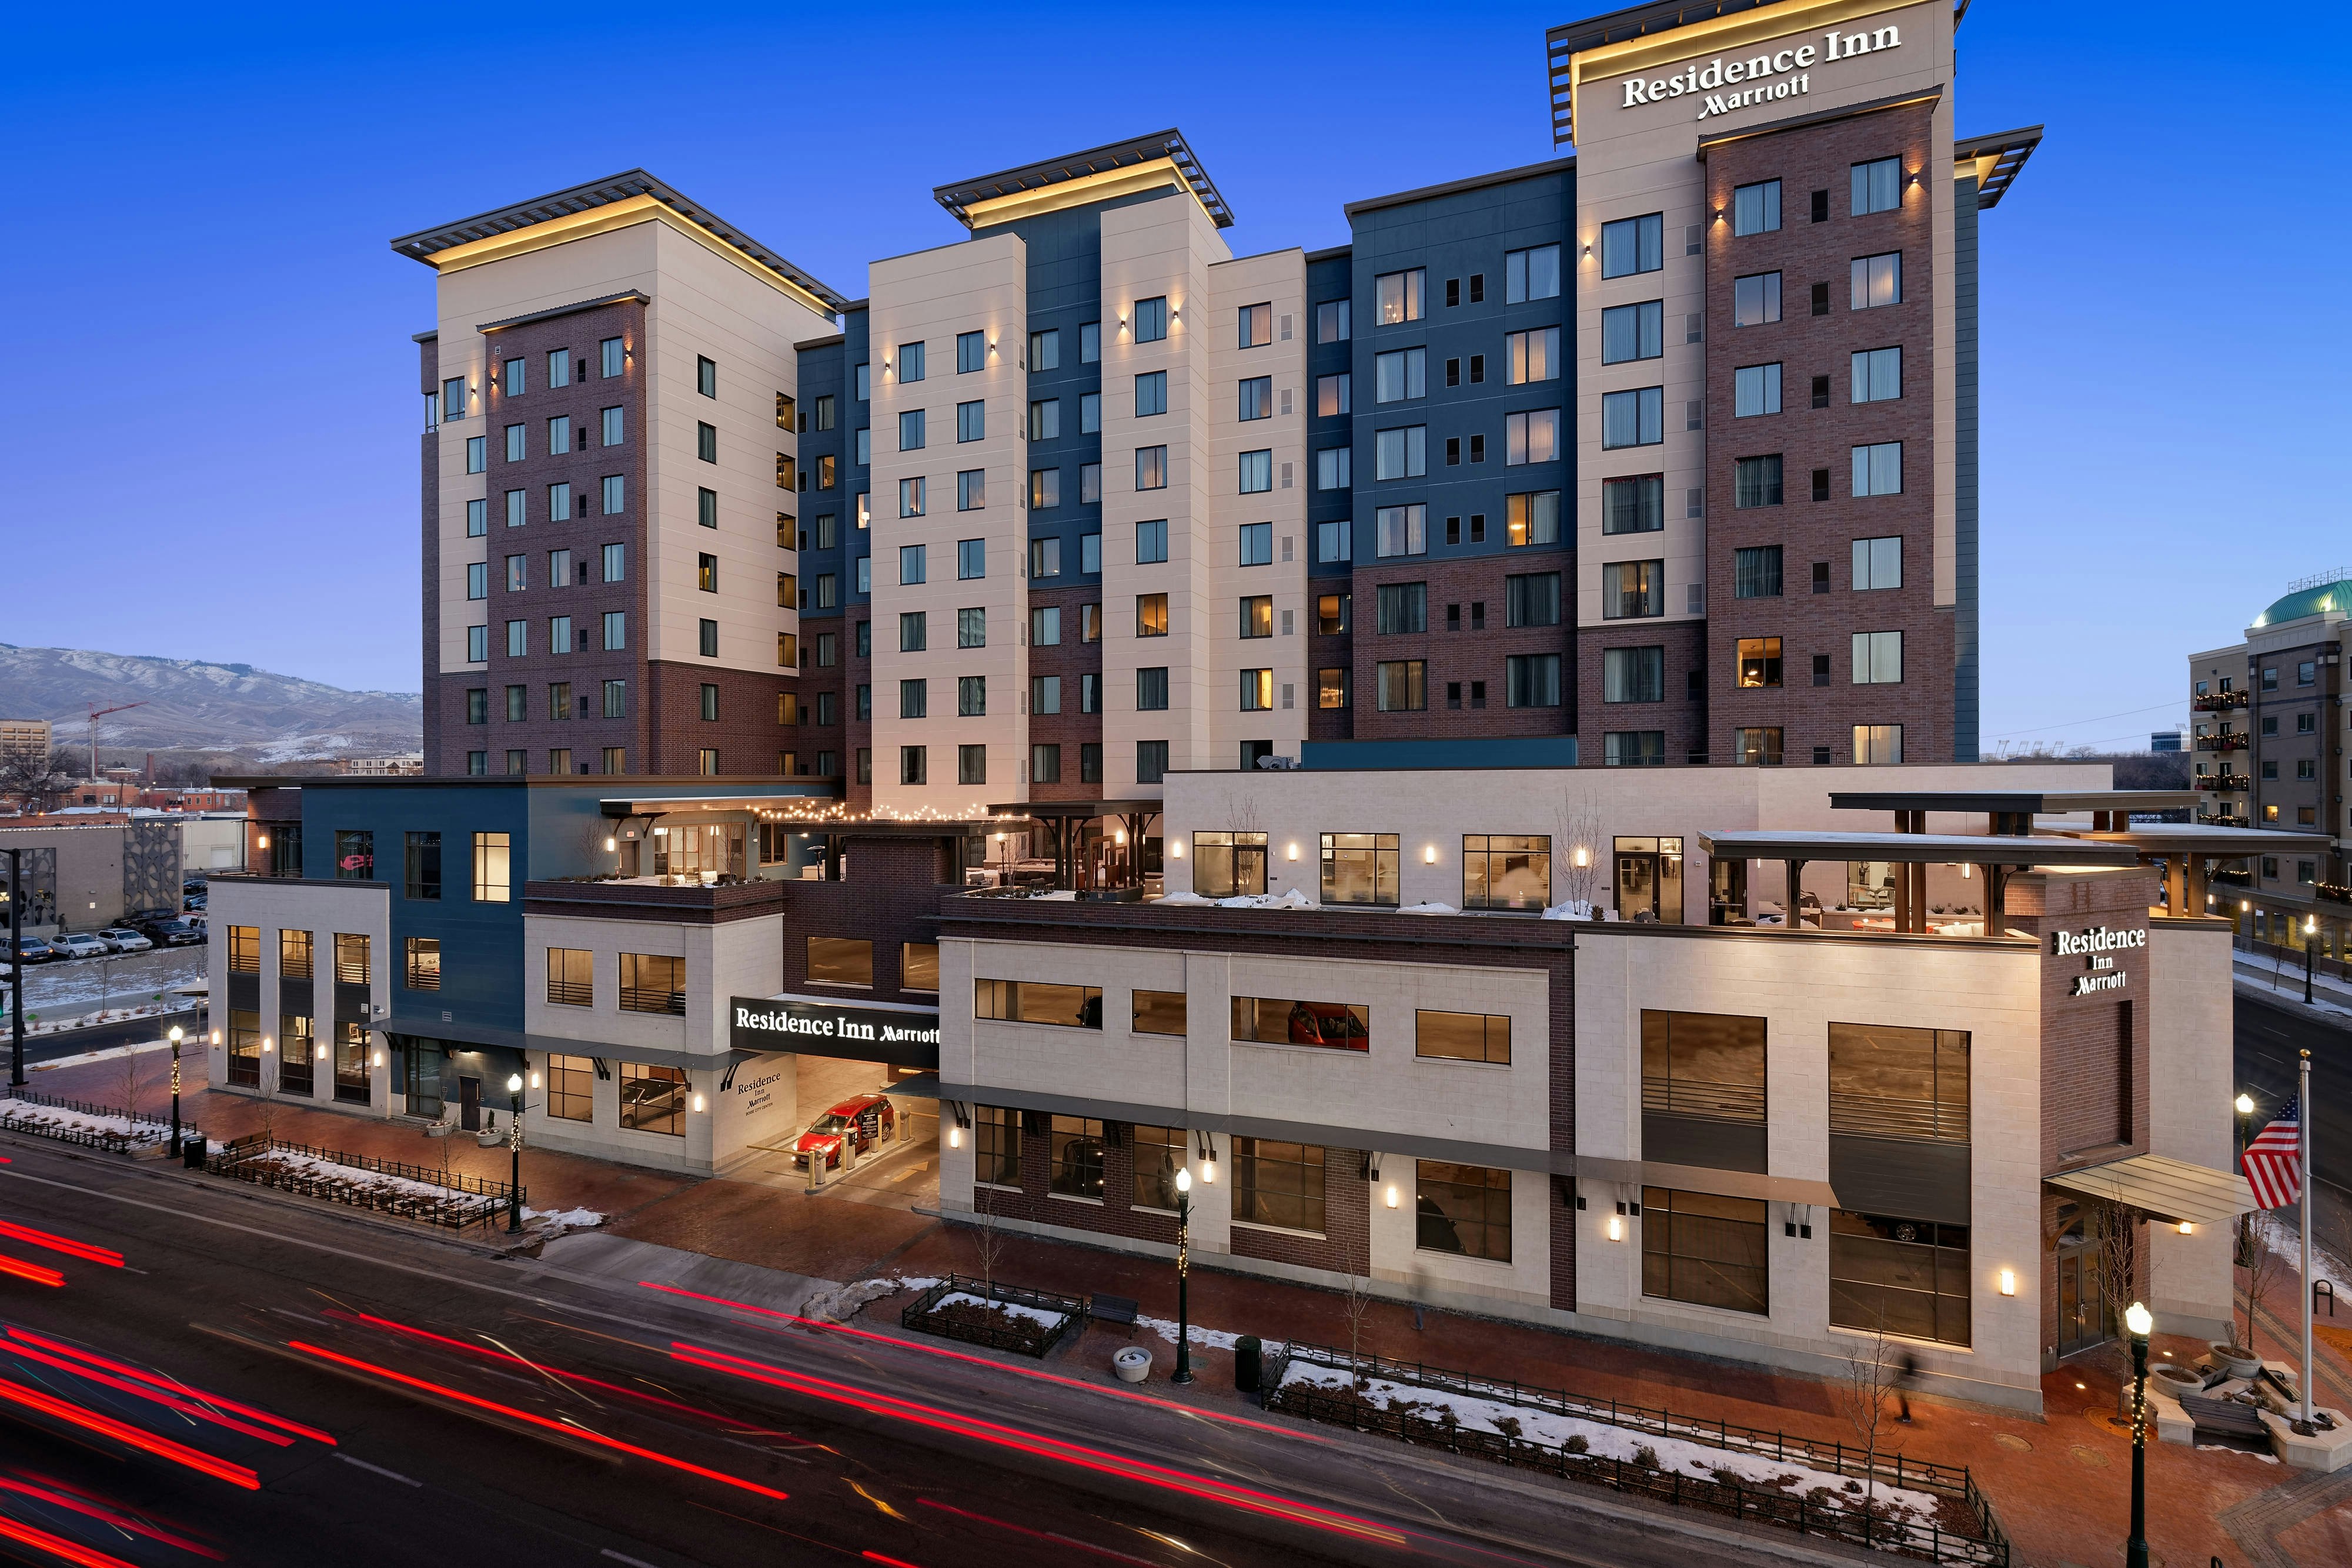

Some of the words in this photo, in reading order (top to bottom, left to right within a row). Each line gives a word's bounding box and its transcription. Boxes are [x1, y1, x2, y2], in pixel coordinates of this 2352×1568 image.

[1622, 44, 1816, 108] Residence
[1825, 25, 1902, 63] Inn
[1698, 73, 1809, 120] Marriott
[2057, 927, 2146, 955] Residence
[2093, 955, 2113, 970] Inn
[2076, 971, 2126, 997] Marriott
[736, 1007, 833, 1036] Residence
[837, 1017, 875, 1041] Inn
[880, 1025, 940, 1044] Marriott
[738, 1072, 781, 1095] Residence
[754, 1088, 765, 1096] Inn
[747, 1093, 770, 1109] Marriott
